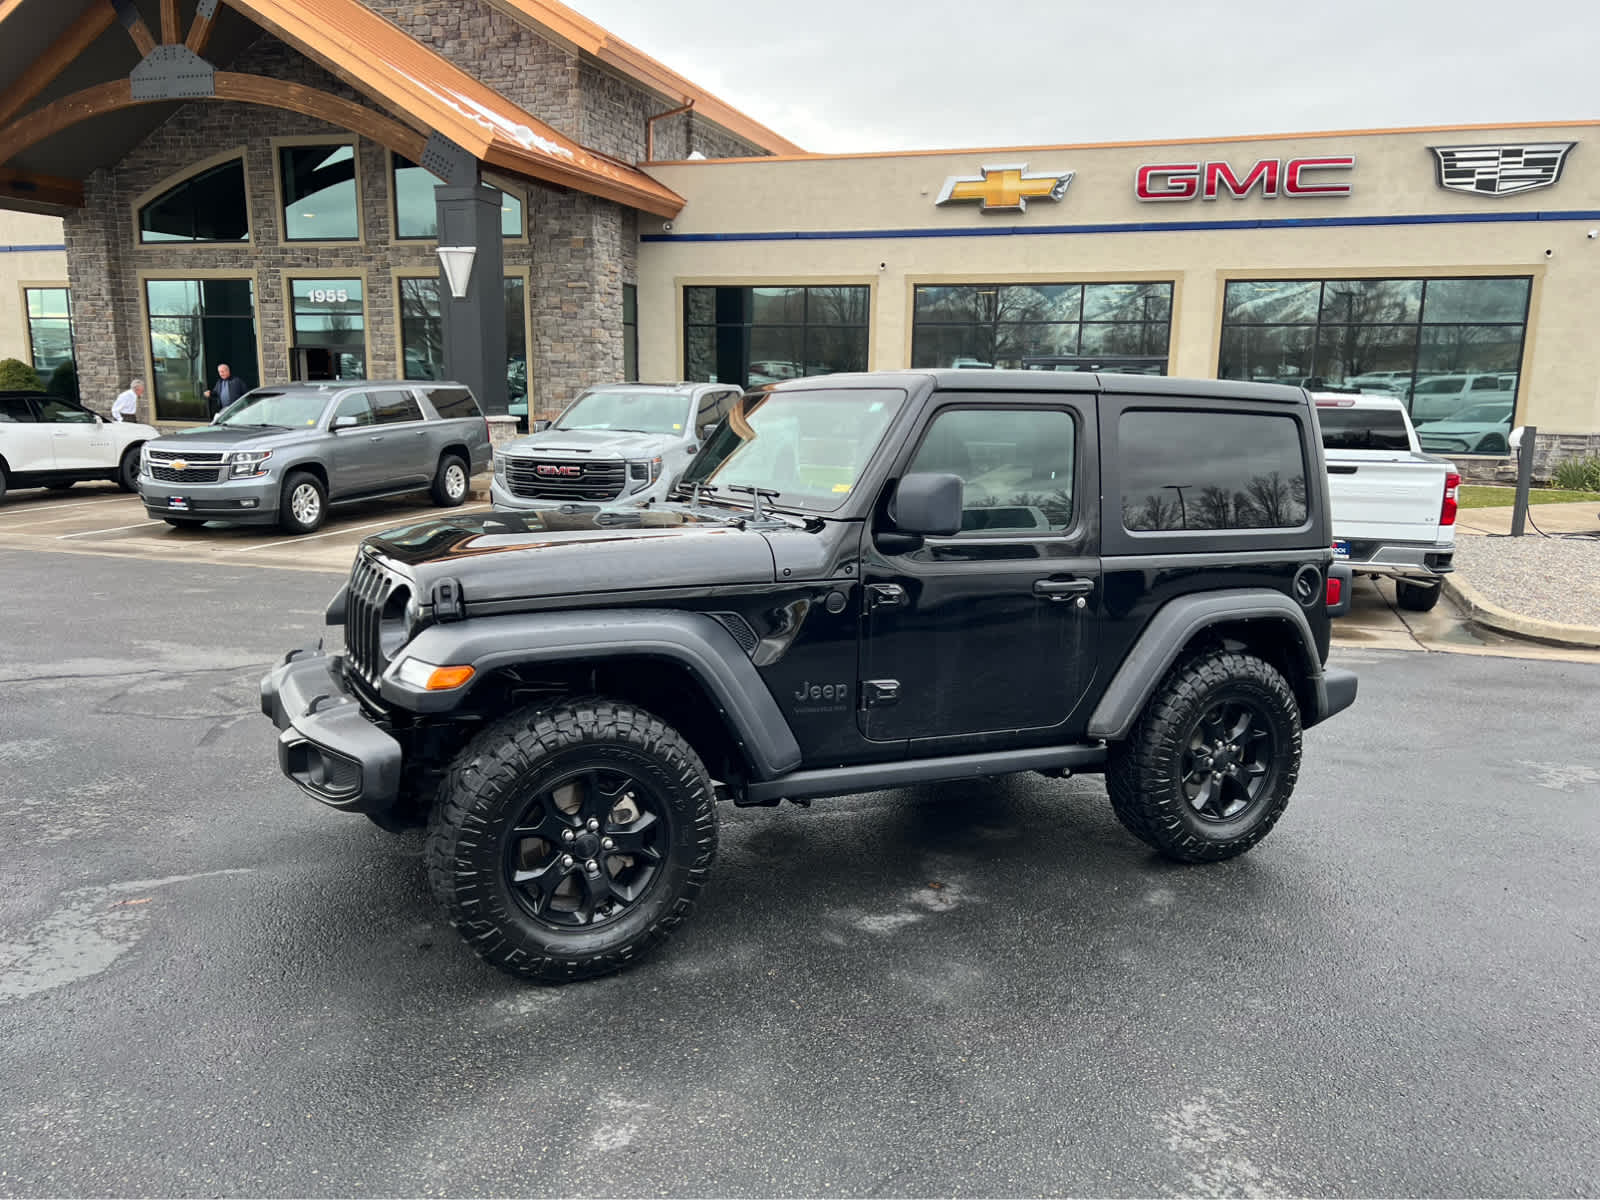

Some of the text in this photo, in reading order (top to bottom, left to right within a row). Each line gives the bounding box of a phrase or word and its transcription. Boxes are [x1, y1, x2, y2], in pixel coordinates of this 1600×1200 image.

[1136, 155, 1355, 202] GMC
[307, 289, 348, 303] 1955
[536, 464, 581, 476] GMC
[795, 681, 848, 702] Jeep
